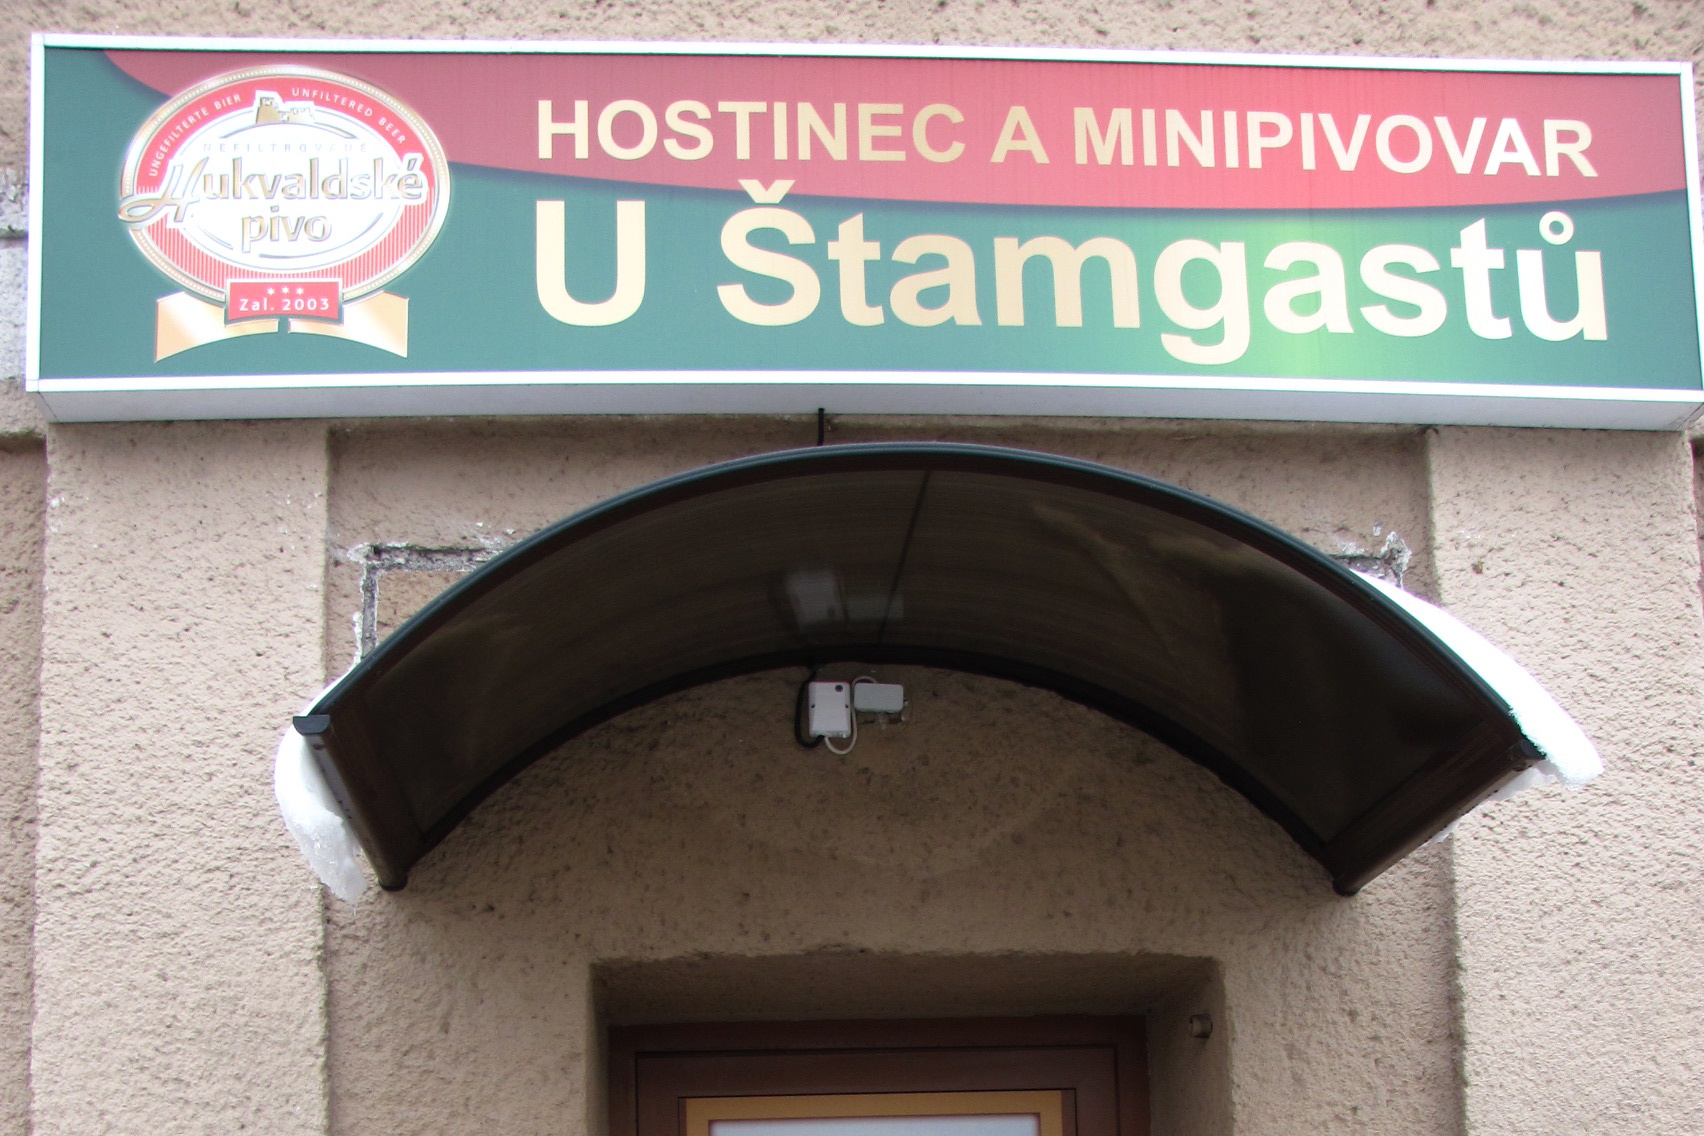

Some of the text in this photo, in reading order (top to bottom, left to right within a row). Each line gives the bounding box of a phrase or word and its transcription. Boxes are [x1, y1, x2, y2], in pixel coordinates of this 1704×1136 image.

[149, 93, 242, 177] UNGEFILTERTE BIER
[291, 87, 407, 145] UNFILTERED BEER
[536, 99, 1599, 178] HOSTINEC A MINIPIVOVAR
[118, 152, 424, 223] Hukvaldské
[241, 204, 332, 253] pivo
[239, 298, 331, 312] Zal. 2003
[536, 179, 1609, 366] U Štamgastů
